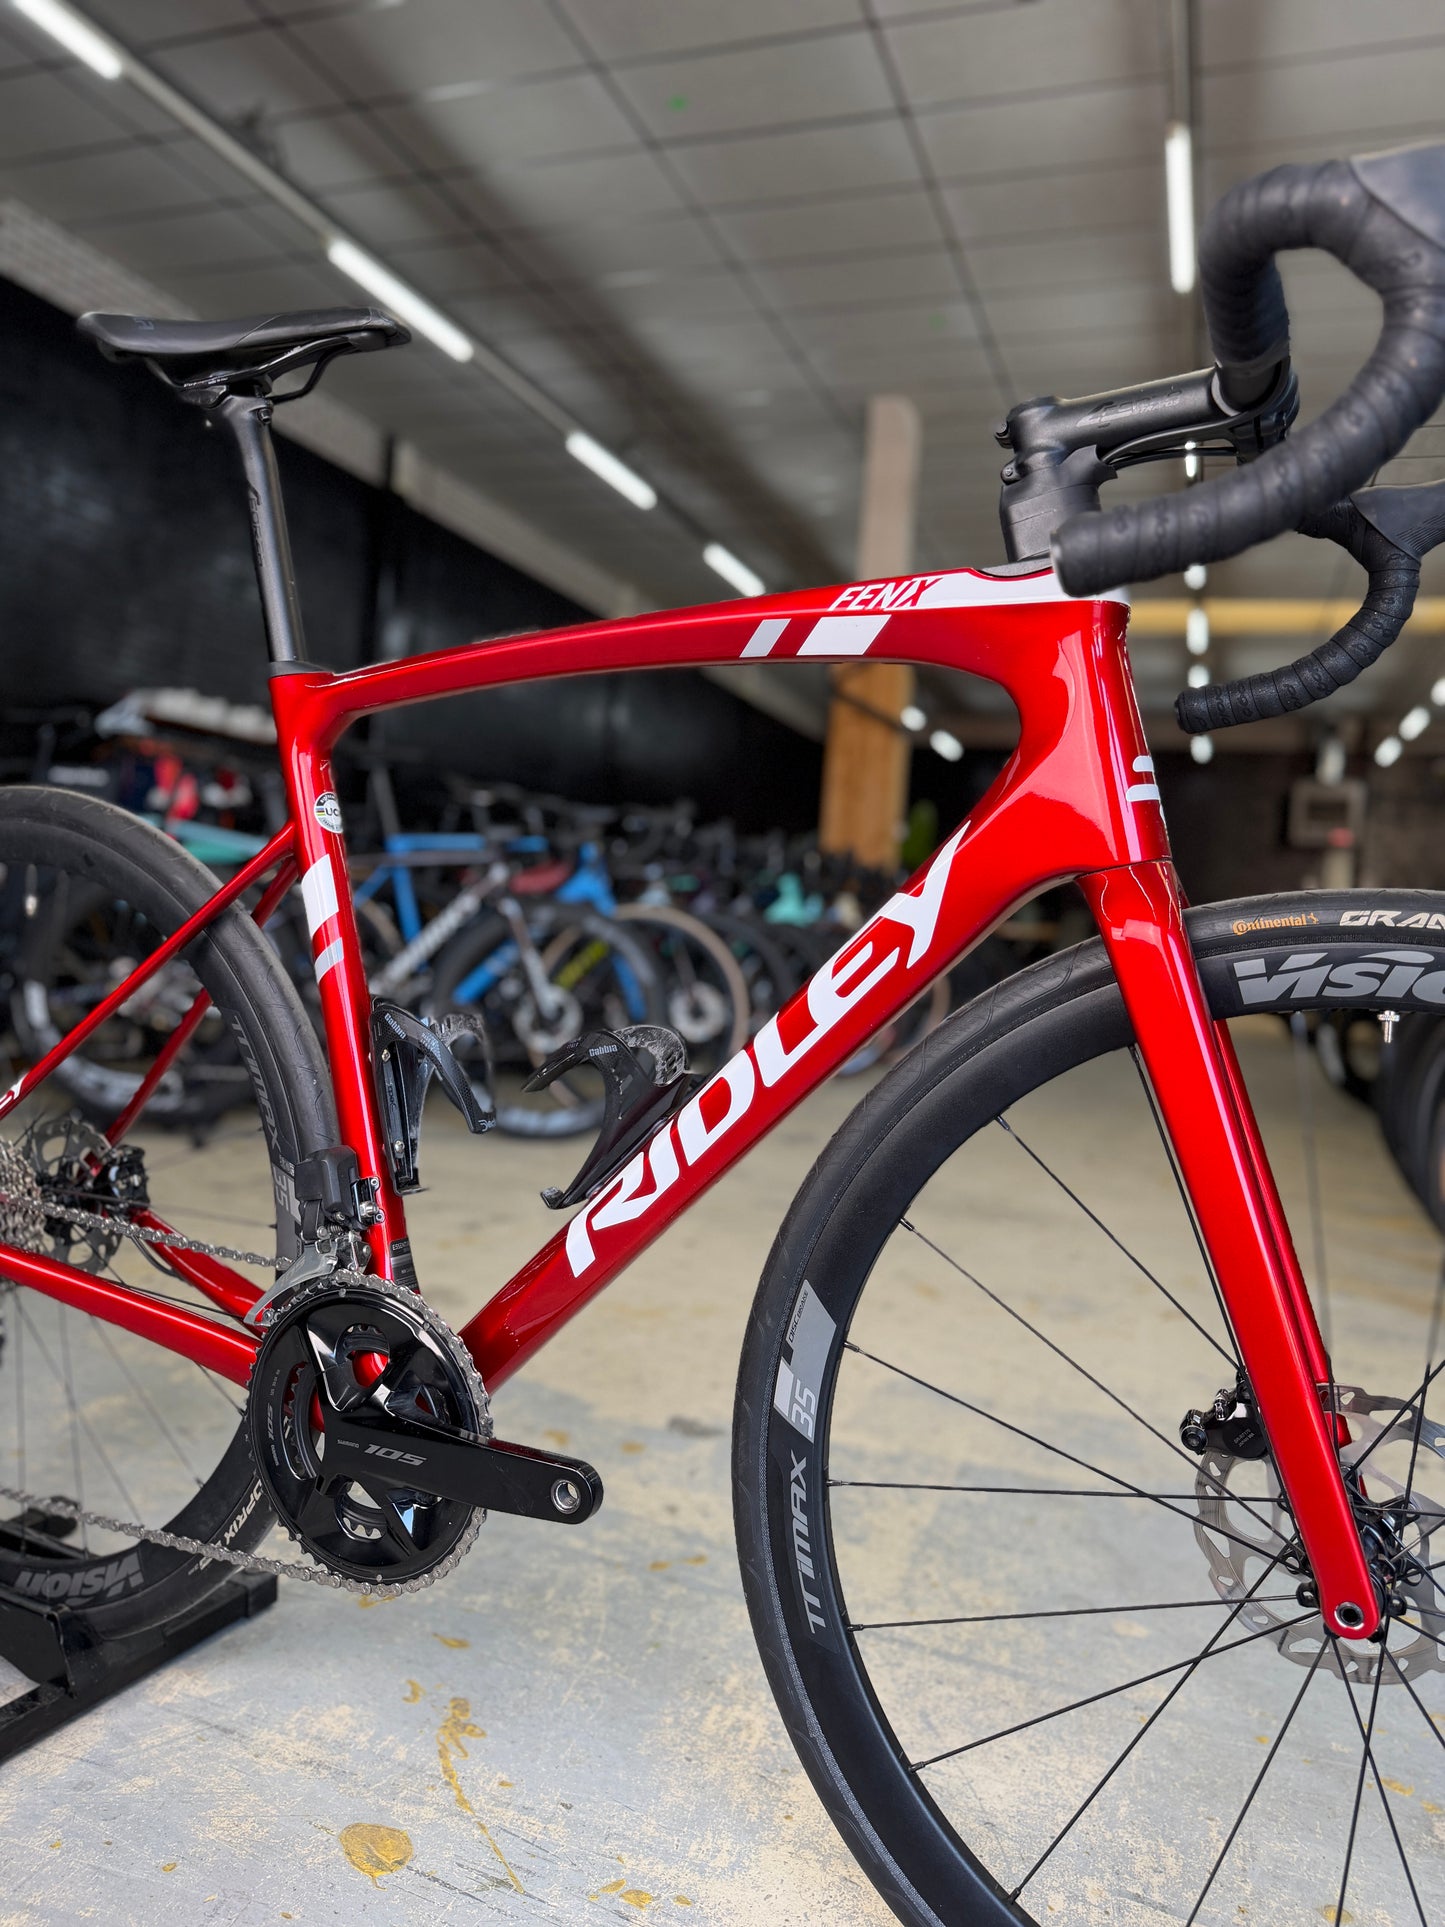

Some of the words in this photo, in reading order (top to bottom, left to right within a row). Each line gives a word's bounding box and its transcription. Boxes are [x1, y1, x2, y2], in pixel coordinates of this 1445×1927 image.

[826, 577, 944, 611] FENIX
[1232, 912, 1307, 936] Continental
[384, 1012, 408, 1040] Gabbia
[565, 820, 971, 1278] RIDLEY
[588, 1043, 618, 1057] Gabbia
[273, 1166, 290, 1212] 35
[790, 1378, 815, 1438] 35
[364, 1444, 428, 1466] 105
